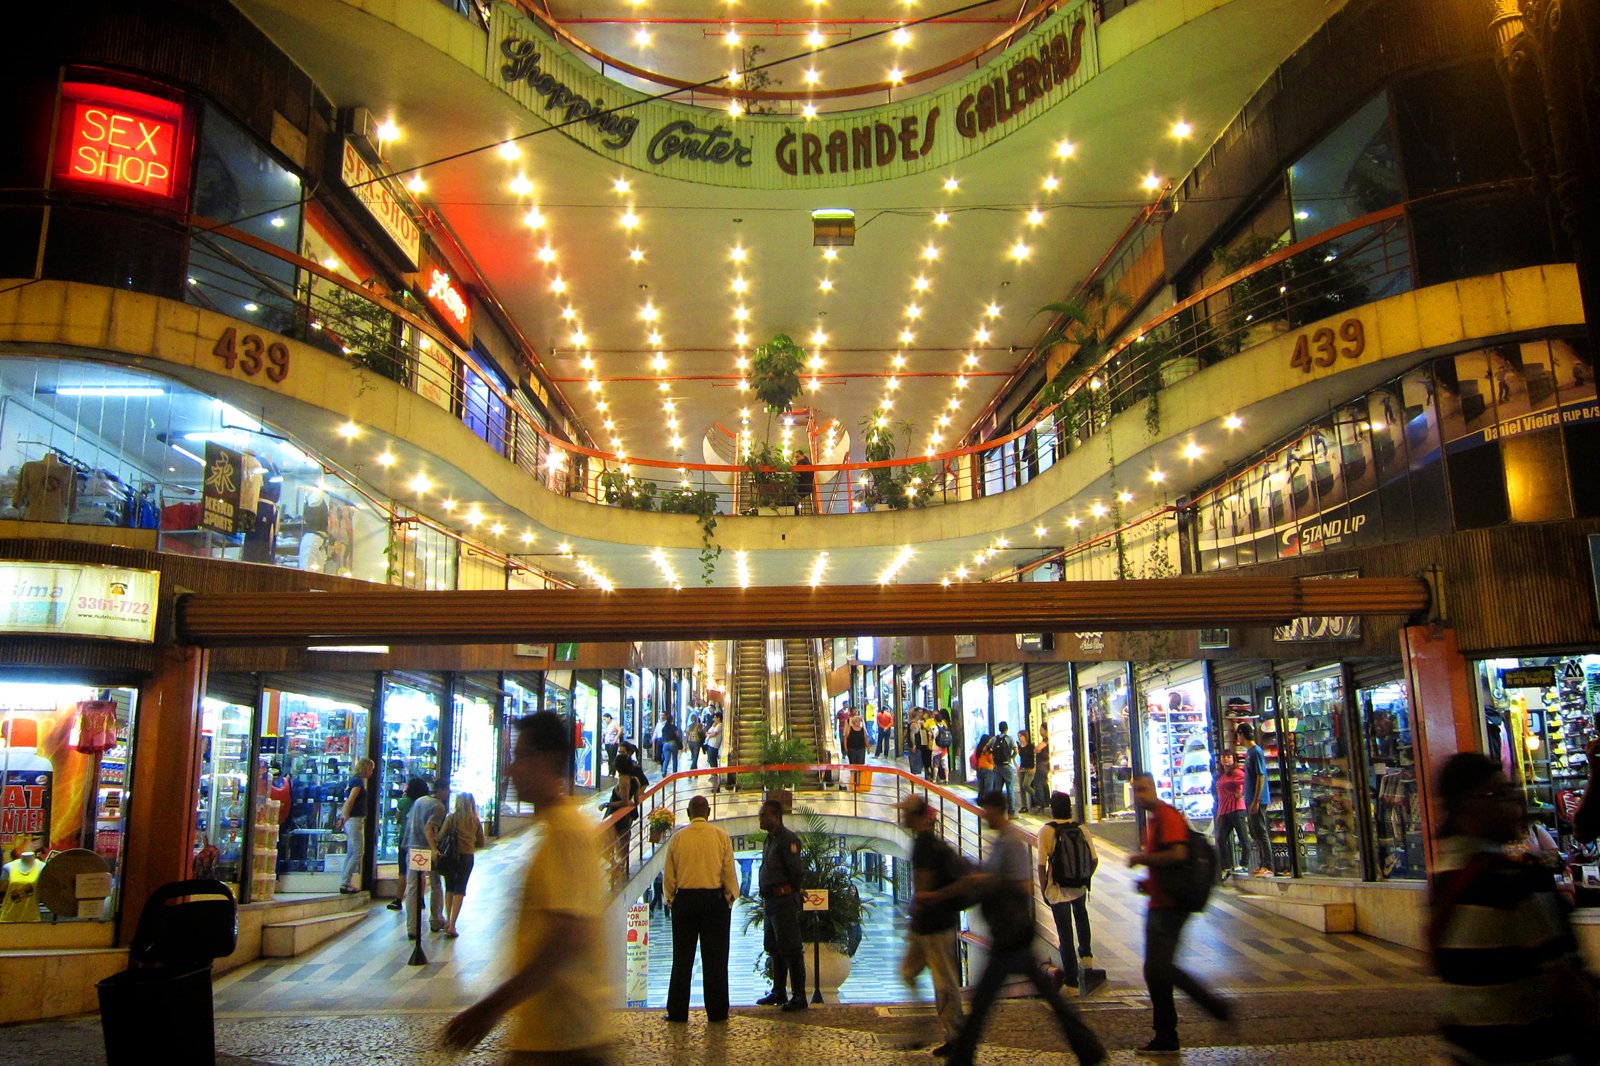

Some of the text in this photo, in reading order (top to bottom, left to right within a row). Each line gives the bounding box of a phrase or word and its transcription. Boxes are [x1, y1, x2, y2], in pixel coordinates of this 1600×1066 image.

[501, 16, 1086, 176] Shopping Center GRANDES GALERIAS
[82, 110, 161, 156] SEX
[75, 146, 168, 187] SHOP
[212, 327, 290, 384] 439
[1290, 318, 1366, 374] 439
[1483, 405, 1600, 443] Daniel Vieira FLIP B/S
[206, 450, 236, 495] 永
[203, 511, 233, 533] SPORTS
[1302, 519, 1342, 546] STAND
[1343, 514, 1366, 535] LIP
[77, 595, 150, 616] 3361-7722
